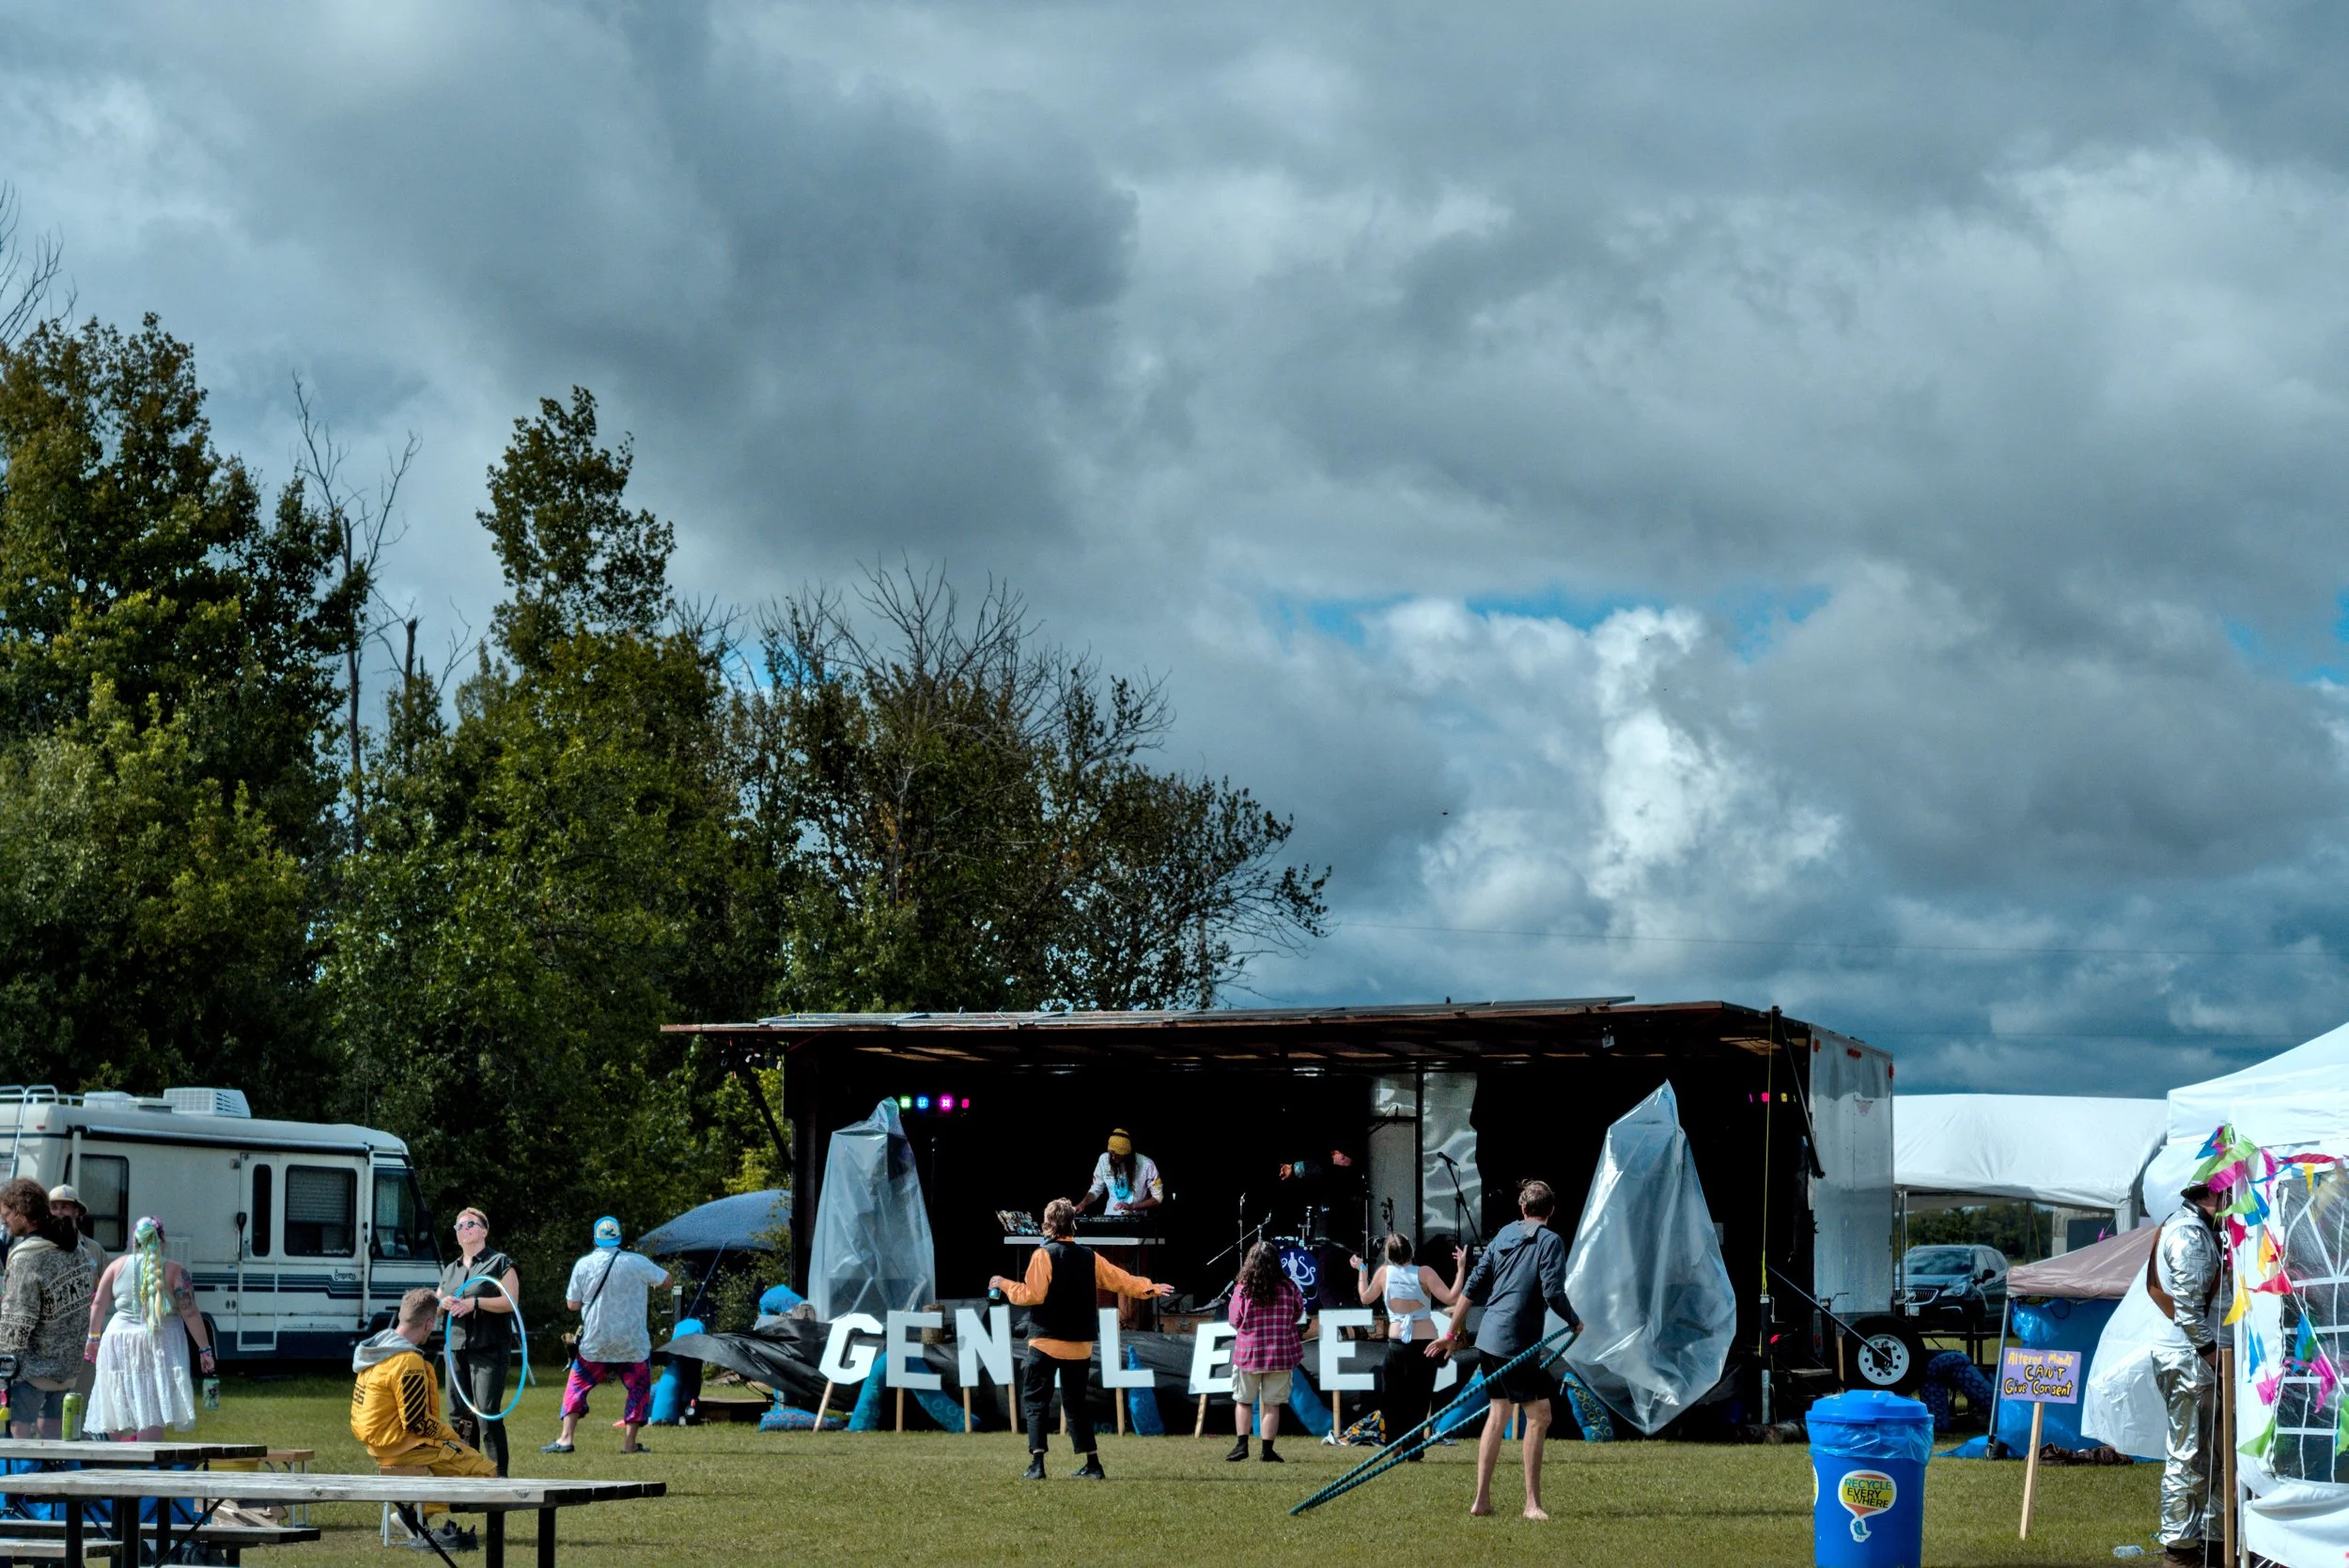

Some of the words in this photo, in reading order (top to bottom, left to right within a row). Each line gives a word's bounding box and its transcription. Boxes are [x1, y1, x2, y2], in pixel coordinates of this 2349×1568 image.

[2007, 1351, 2044, 1366] Altered
[2047, 1353, 2074, 1367] Minds
[2024, 1364, 2066, 1382] CAN'T
[2004, 1377, 2028, 1395] Give
[2031, 1379, 2073, 1397] Consent
[1844, 1478, 1892, 1491] RECYCLE
[1846, 1487, 1882, 1498] EVERY
[1852, 1495, 1889, 1509] WHERE
